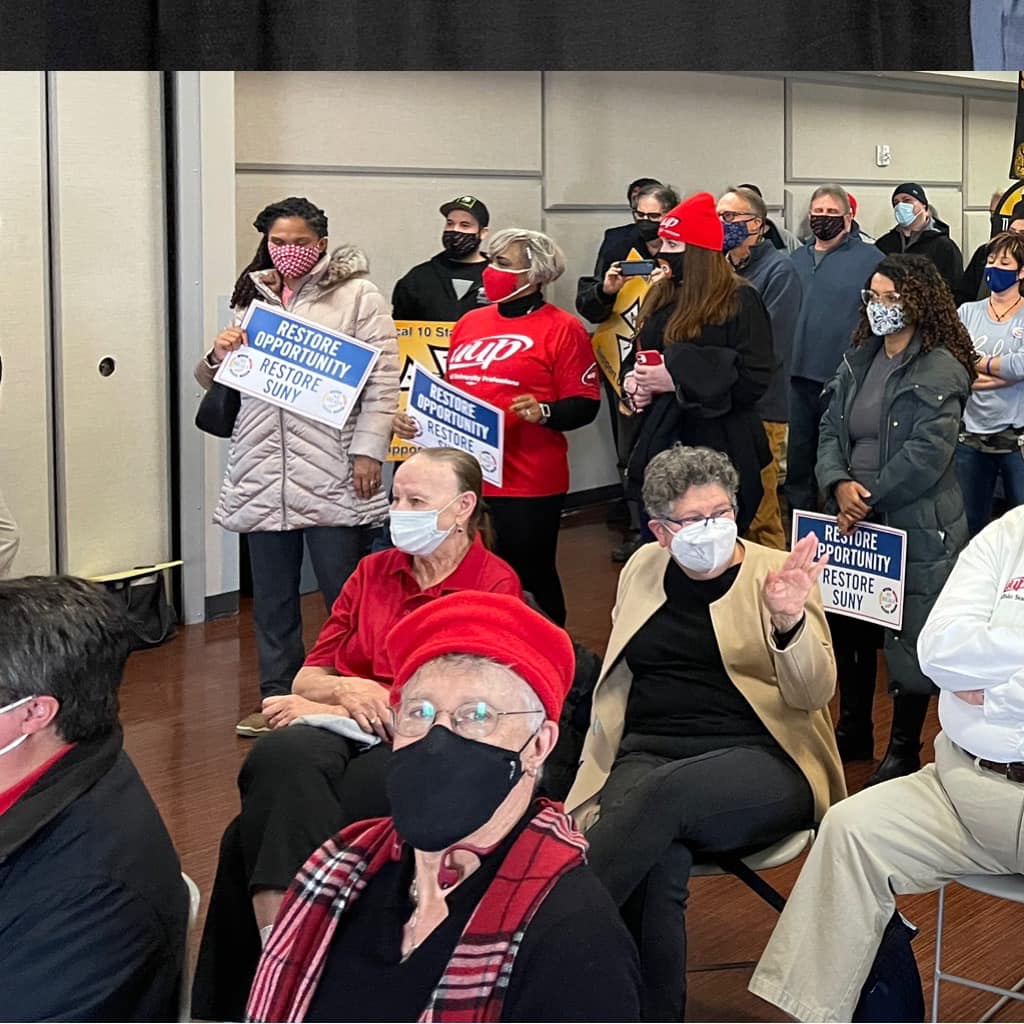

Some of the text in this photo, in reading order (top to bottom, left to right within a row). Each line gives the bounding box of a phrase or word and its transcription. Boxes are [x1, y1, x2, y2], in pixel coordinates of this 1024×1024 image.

[276, 320, 342, 356] RESTORE
[418, 327, 432, 337] 10
[254, 330, 352, 379] OPPORTUNITY
[259, 357, 322, 393] RESTORE
[263, 378, 302, 403] SUNY
[417, 394, 490, 440] OPPORTUNITY
[429, 383, 476, 419] RESTORE
[427, 420, 474, 453] RESTORE
[817, 542, 891, 574] PPORTUNITY
[823, 568, 875, 594] RESTORE
[832, 589, 864, 611] SUNY
